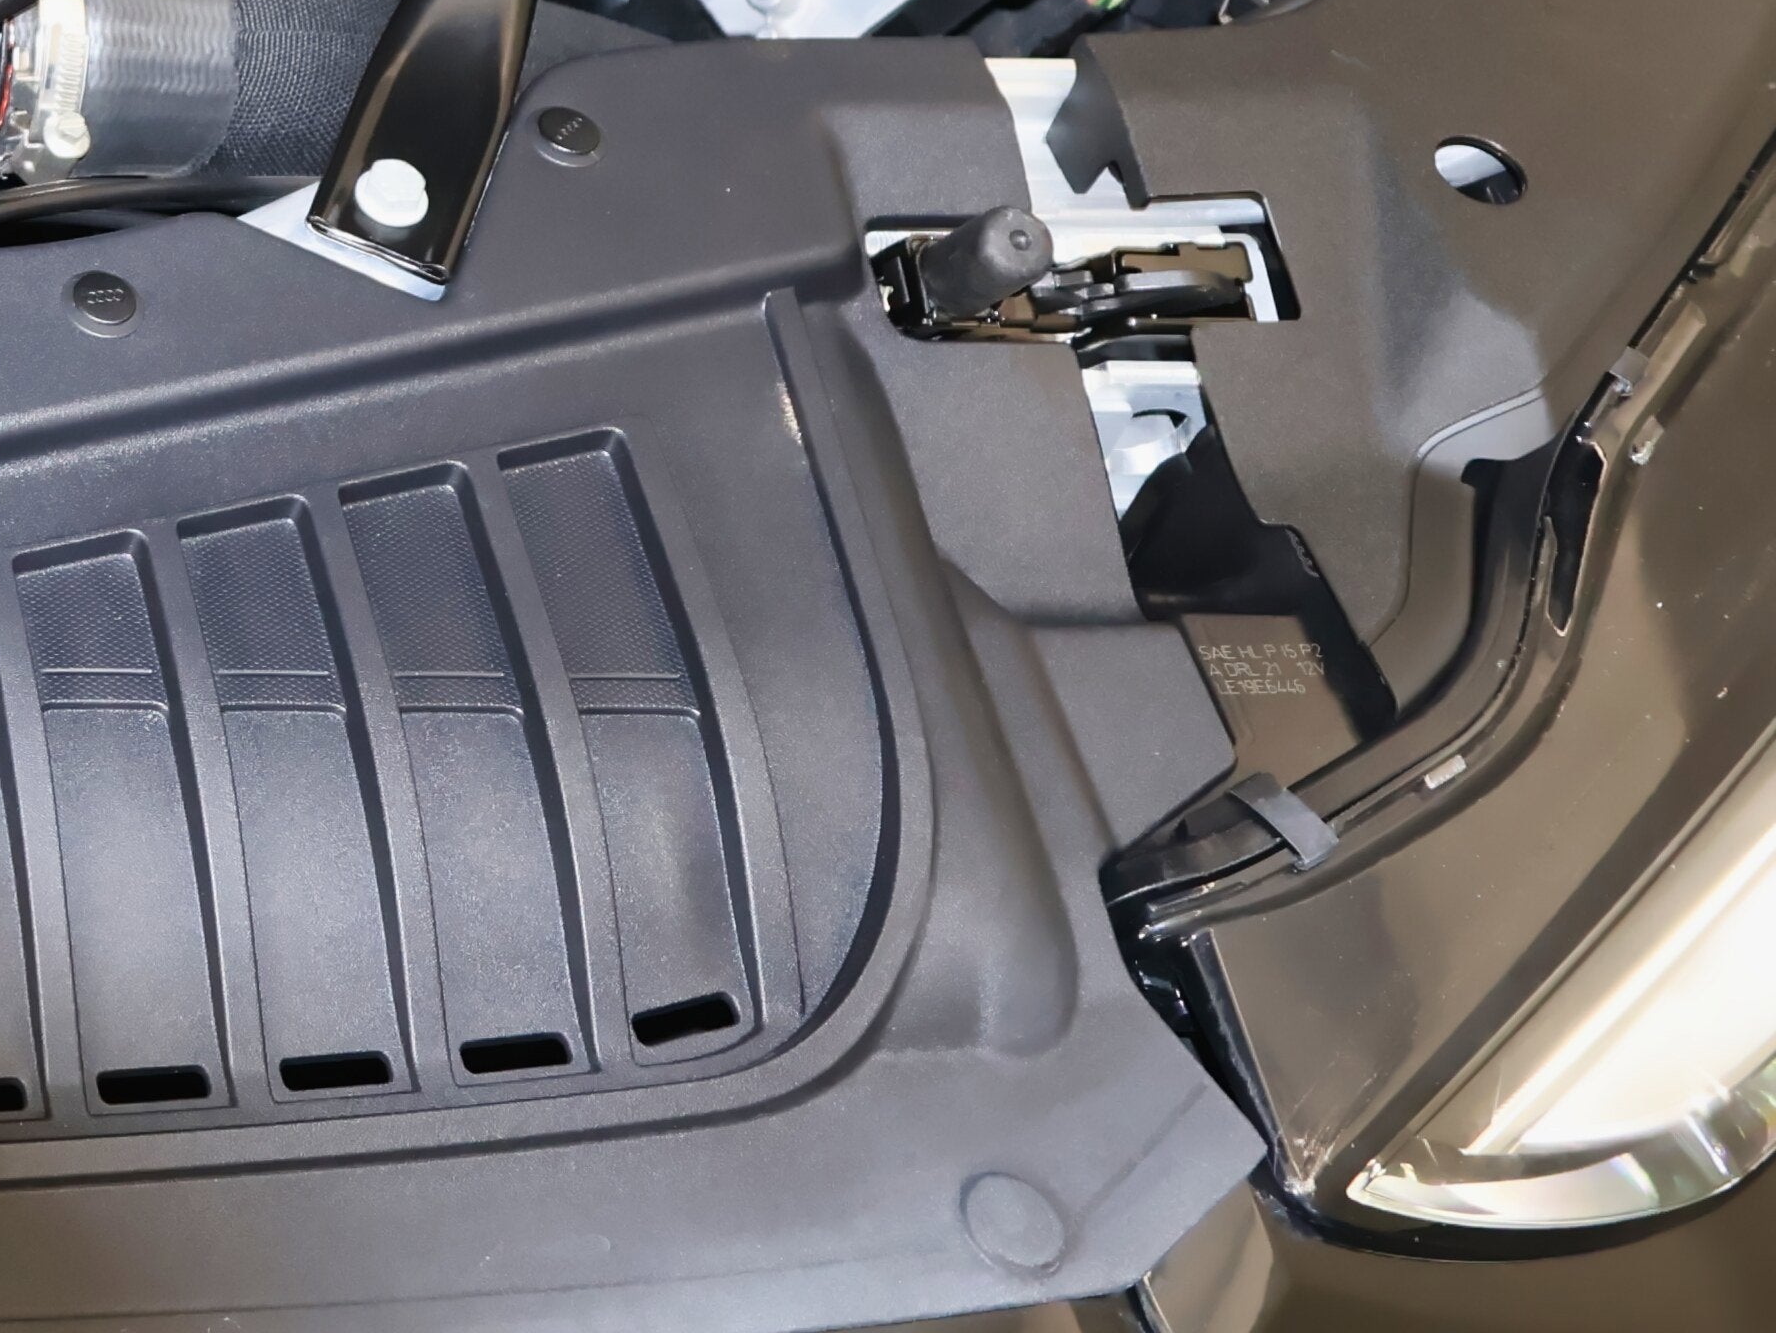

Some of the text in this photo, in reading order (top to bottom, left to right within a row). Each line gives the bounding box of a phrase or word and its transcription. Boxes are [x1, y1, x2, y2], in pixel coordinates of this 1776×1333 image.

[1198, 644, 1236, 660] SAE
[1237, 645, 1262, 659] HL
[1264, 644, 1276, 657] P
[1300, 644, 1324, 658] P2
[1210, 663, 1222, 677] A
[1224, 662, 1260, 677] DRL
[1296, 661, 1325, 675] 12V
